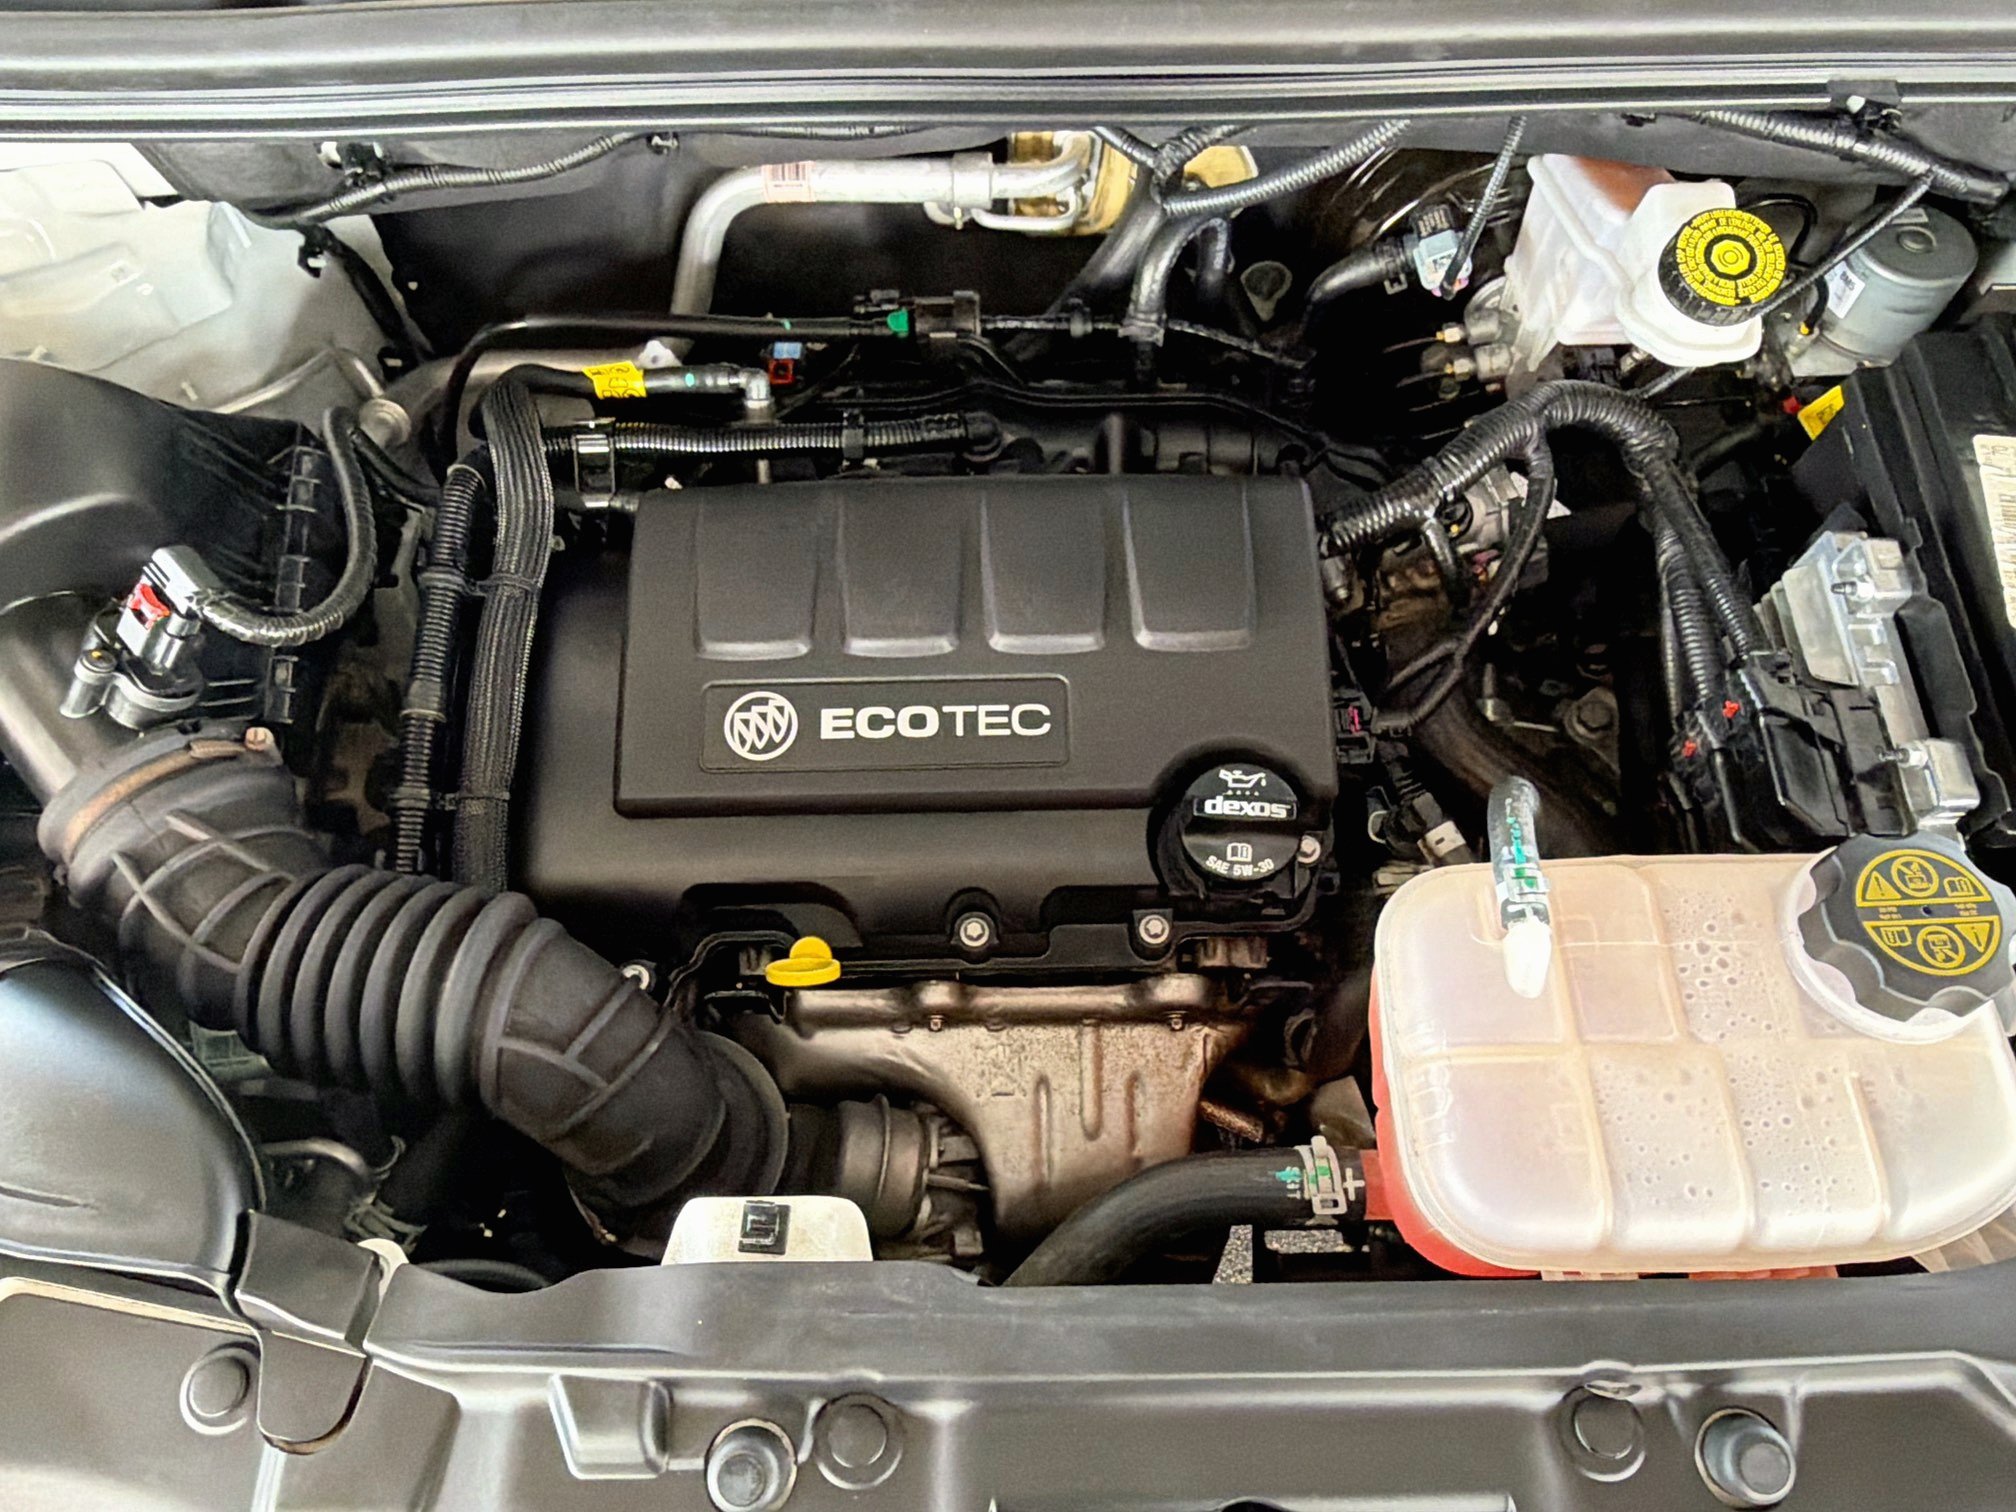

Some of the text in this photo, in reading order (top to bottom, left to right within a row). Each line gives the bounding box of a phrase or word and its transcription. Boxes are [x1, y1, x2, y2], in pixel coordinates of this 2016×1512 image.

[820, 703, 1051, 740] ECOTEC
[1204, 796, 1292, 818] dexos
[1205, 855, 1275, 876] SAE 5W-30
